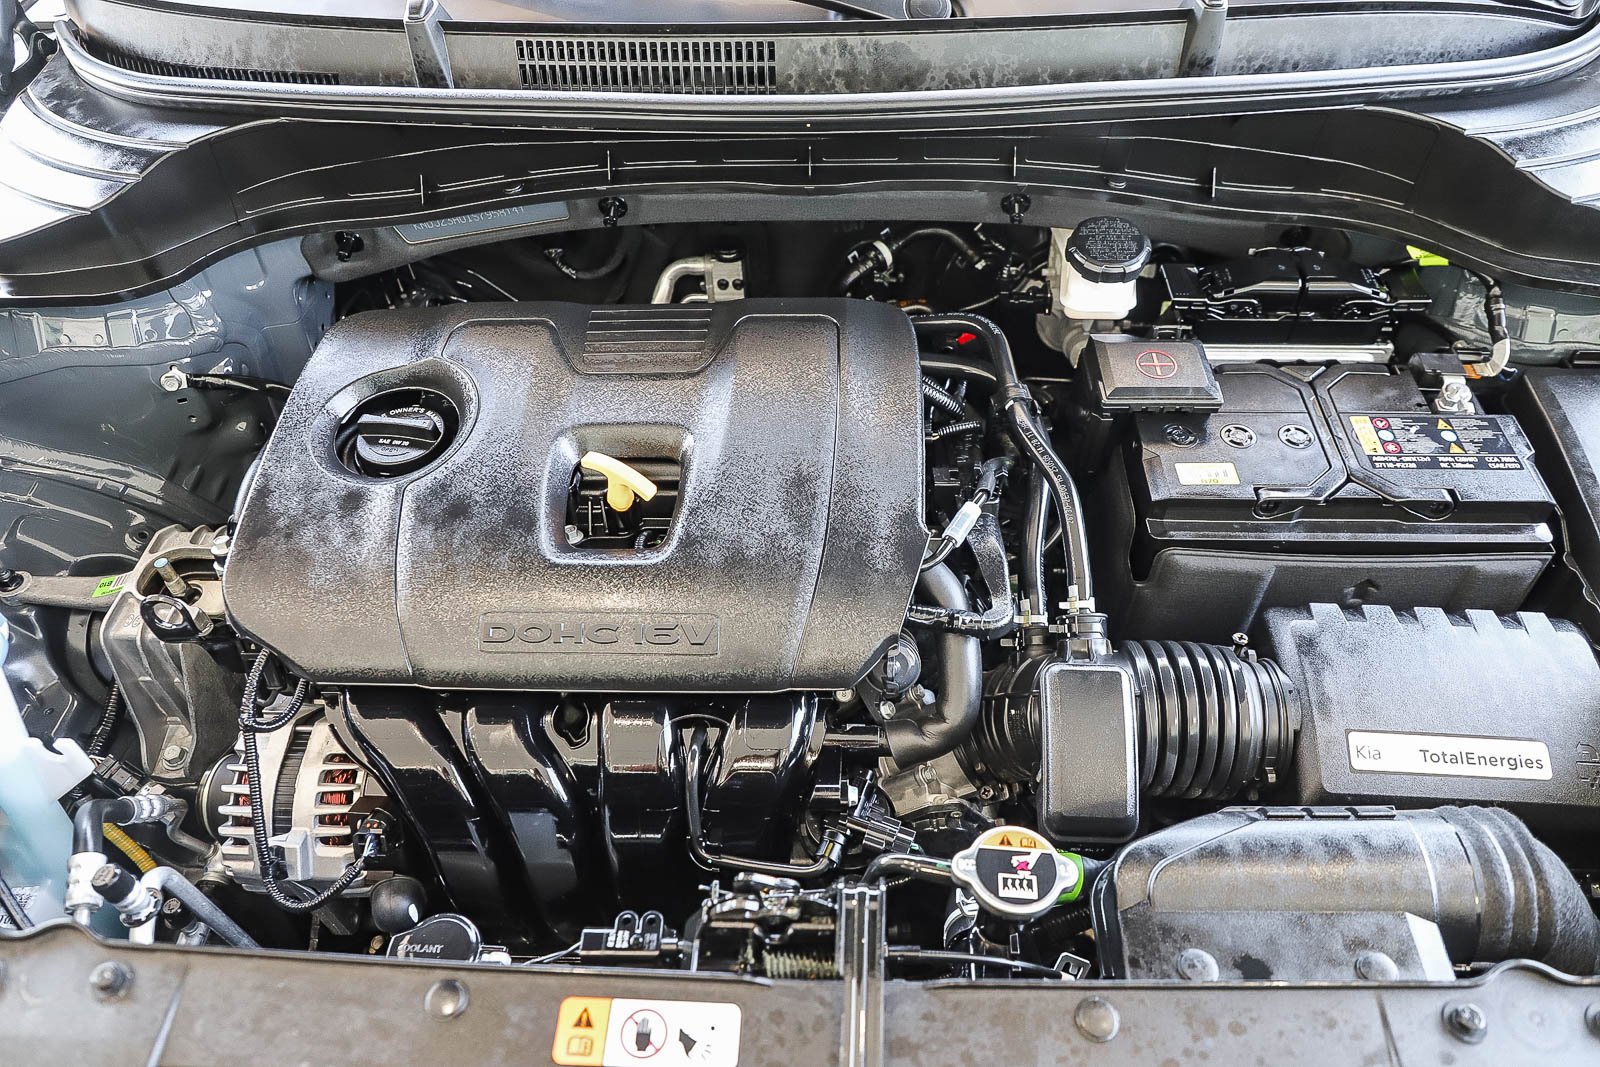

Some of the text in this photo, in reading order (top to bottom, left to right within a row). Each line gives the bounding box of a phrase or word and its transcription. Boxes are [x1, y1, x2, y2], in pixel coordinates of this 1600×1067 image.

[389, 406, 426, 416] OWNER'S
[482, 622, 718, 646] DOHC 16V
[1355, 745, 1544, 771] Kia TotalEnergies
